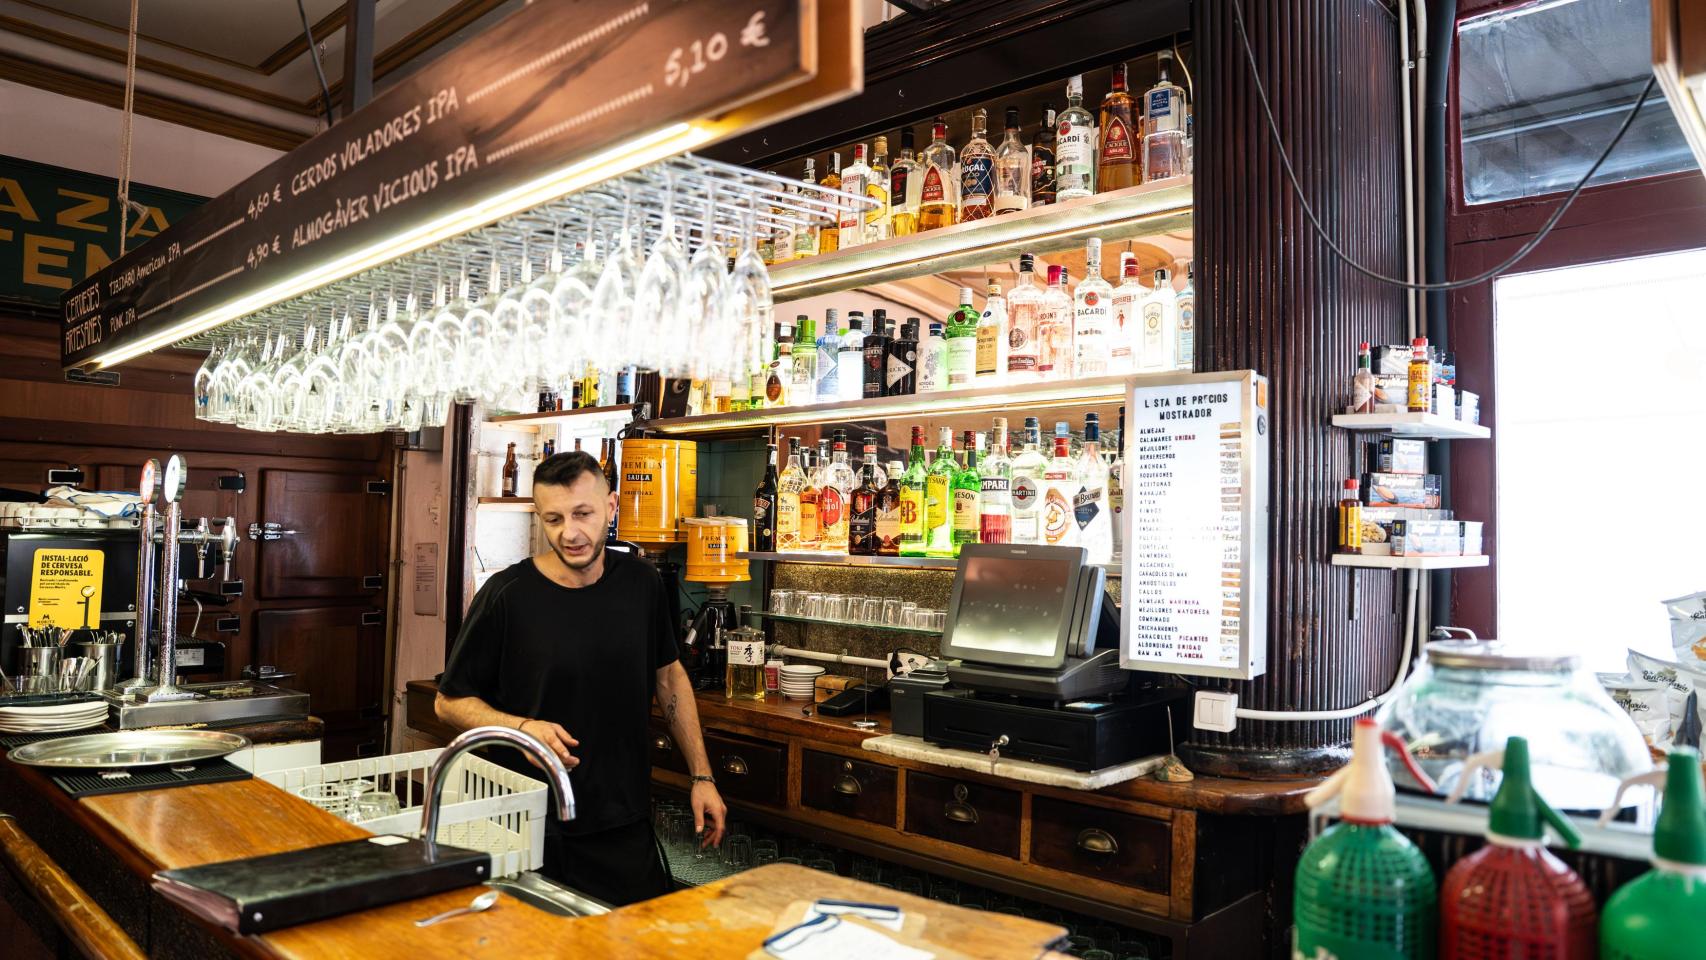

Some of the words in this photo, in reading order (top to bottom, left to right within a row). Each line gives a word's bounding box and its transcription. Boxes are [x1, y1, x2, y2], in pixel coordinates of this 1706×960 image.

[291, 153, 337, 196] CERDOS
[340, 105, 422, 171] VOLADORES
[426, 86, 459, 124] IPA
[292, 198, 370, 249] ALMOGÀVER
[373, 160, 439, 213] VICIOUS
[444, 144, 479, 182] IPA
[664, 32, 728, 87] 5,10
[740, 10, 770, 47] €
[109, 269, 136, 297] TIBIDABO
[136, 255, 166, 281] American
[168, 241, 181, 263] IPA
[247, 192, 270, 221] 4,60
[272, 184, 282, 203] €
[65, 282, 100, 324] CERVESES
[110, 315, 124, 333] PUNK
[125, 307, 136, 326] IPA
[246, 245, 269, 270] 4,90
[271, 235, 282, 254] €
[65, 315, 102, 355] ARTESANES
[1159, 408, 1212, 420] MOSTRADOR
[1176, 396, 1187, 406] DE
[1139, 435, 1172, 443] CALAMARES
[981, 479, 1007, 490] MPARI
[1138, 633, 1172, 641] CARACOLES
